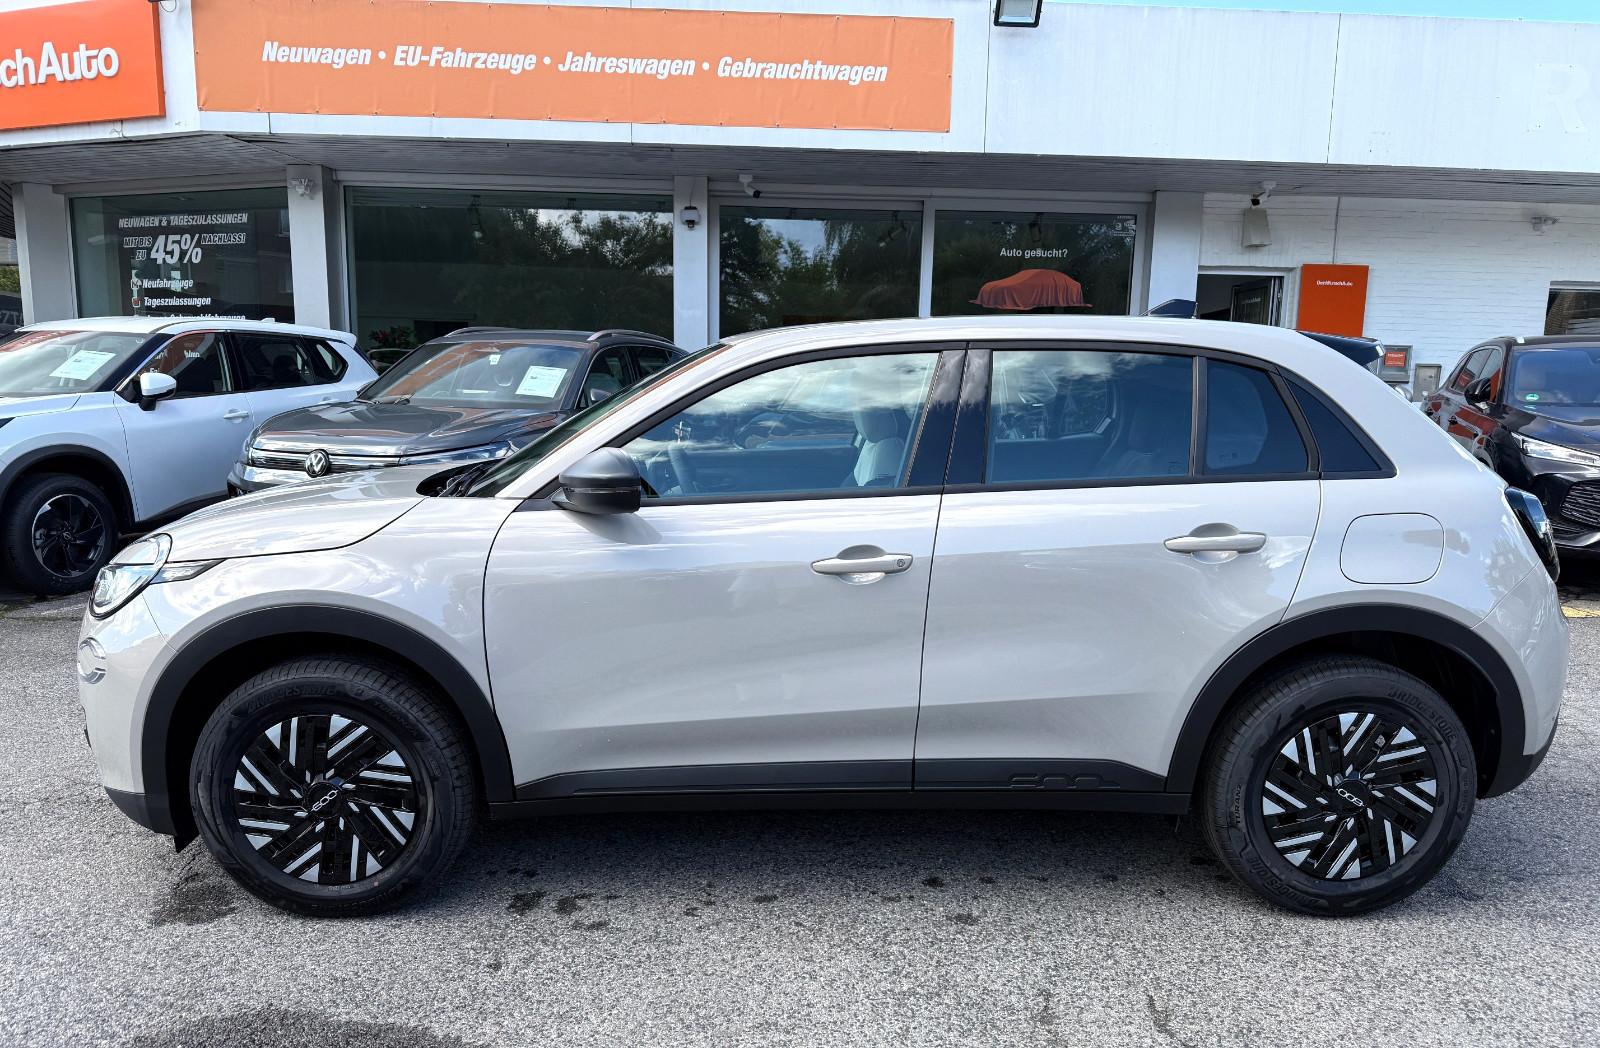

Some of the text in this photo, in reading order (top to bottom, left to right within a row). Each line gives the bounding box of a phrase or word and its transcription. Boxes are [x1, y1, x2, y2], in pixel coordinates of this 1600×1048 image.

[0, 41, 119, 88] chAuto
[262, 40, 888, 86] Neuwagen EU-Fahrzeuge Jahreswagen Gebrauchtwagen
[119, 213, 248, 228] NEUWAGEN & TAGESZULASSUNGEN
[150, 233, 202, 264] 45%
[1000, 247, 1068, 259] Auto gesucht?
[142, 278, 194, 289] Neufahrzeuge
[144, 296, 211, 307] Tageszulassungen
